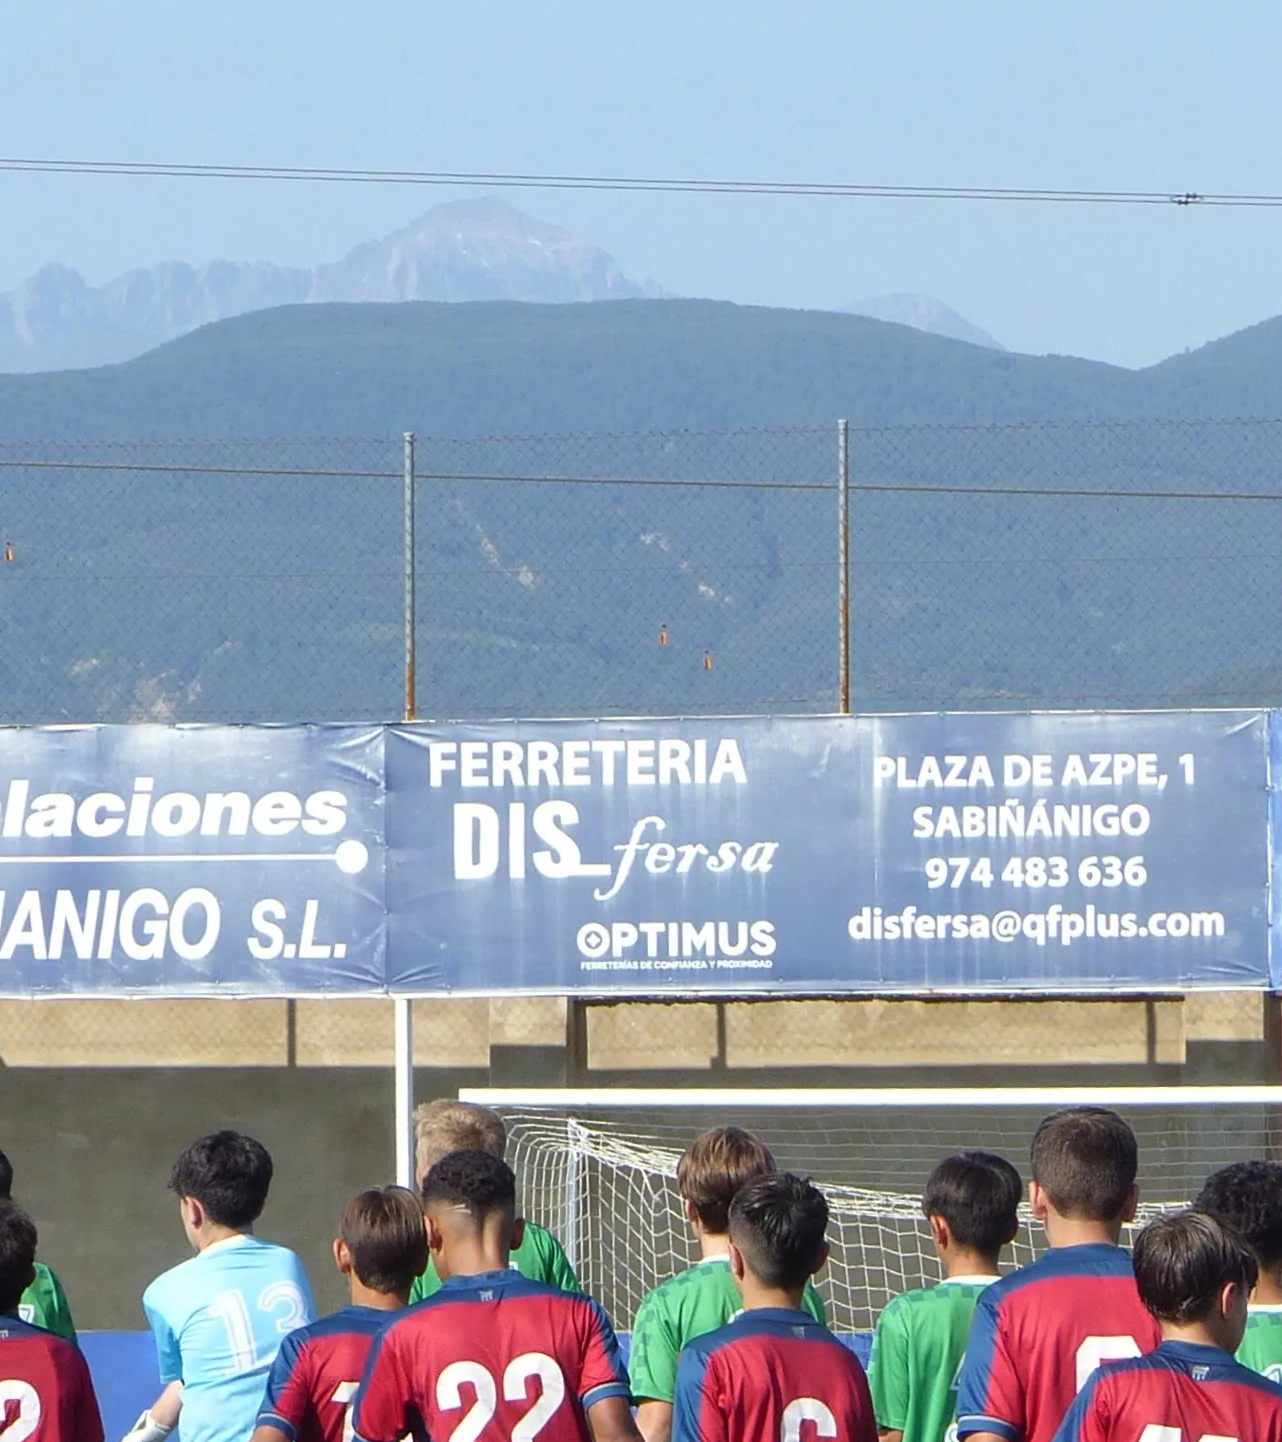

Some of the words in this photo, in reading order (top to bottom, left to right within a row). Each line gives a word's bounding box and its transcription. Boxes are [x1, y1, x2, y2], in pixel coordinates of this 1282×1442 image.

[428, 738, 748, 788] FERRETERIA
[873, 754, 995, 790] PLAZA
[1003, 754, 1053, 787] DE
[1061, 753, 1169, 790] AZPE,
[1178, 753, 1195, 785] 1
[912, 798, 1151, 838] SABIÑÁNIGO
[924, 856, 994, 889] 974
[1000, 856, 1069, 888] 483
[1077, 855, 1148, 887] 636
[247, 898, 347, 960] S.L.
[576, 920, 777, 959] OPTIMUS
[847, 903, 1226, 946] disfersa@qfplus.com
